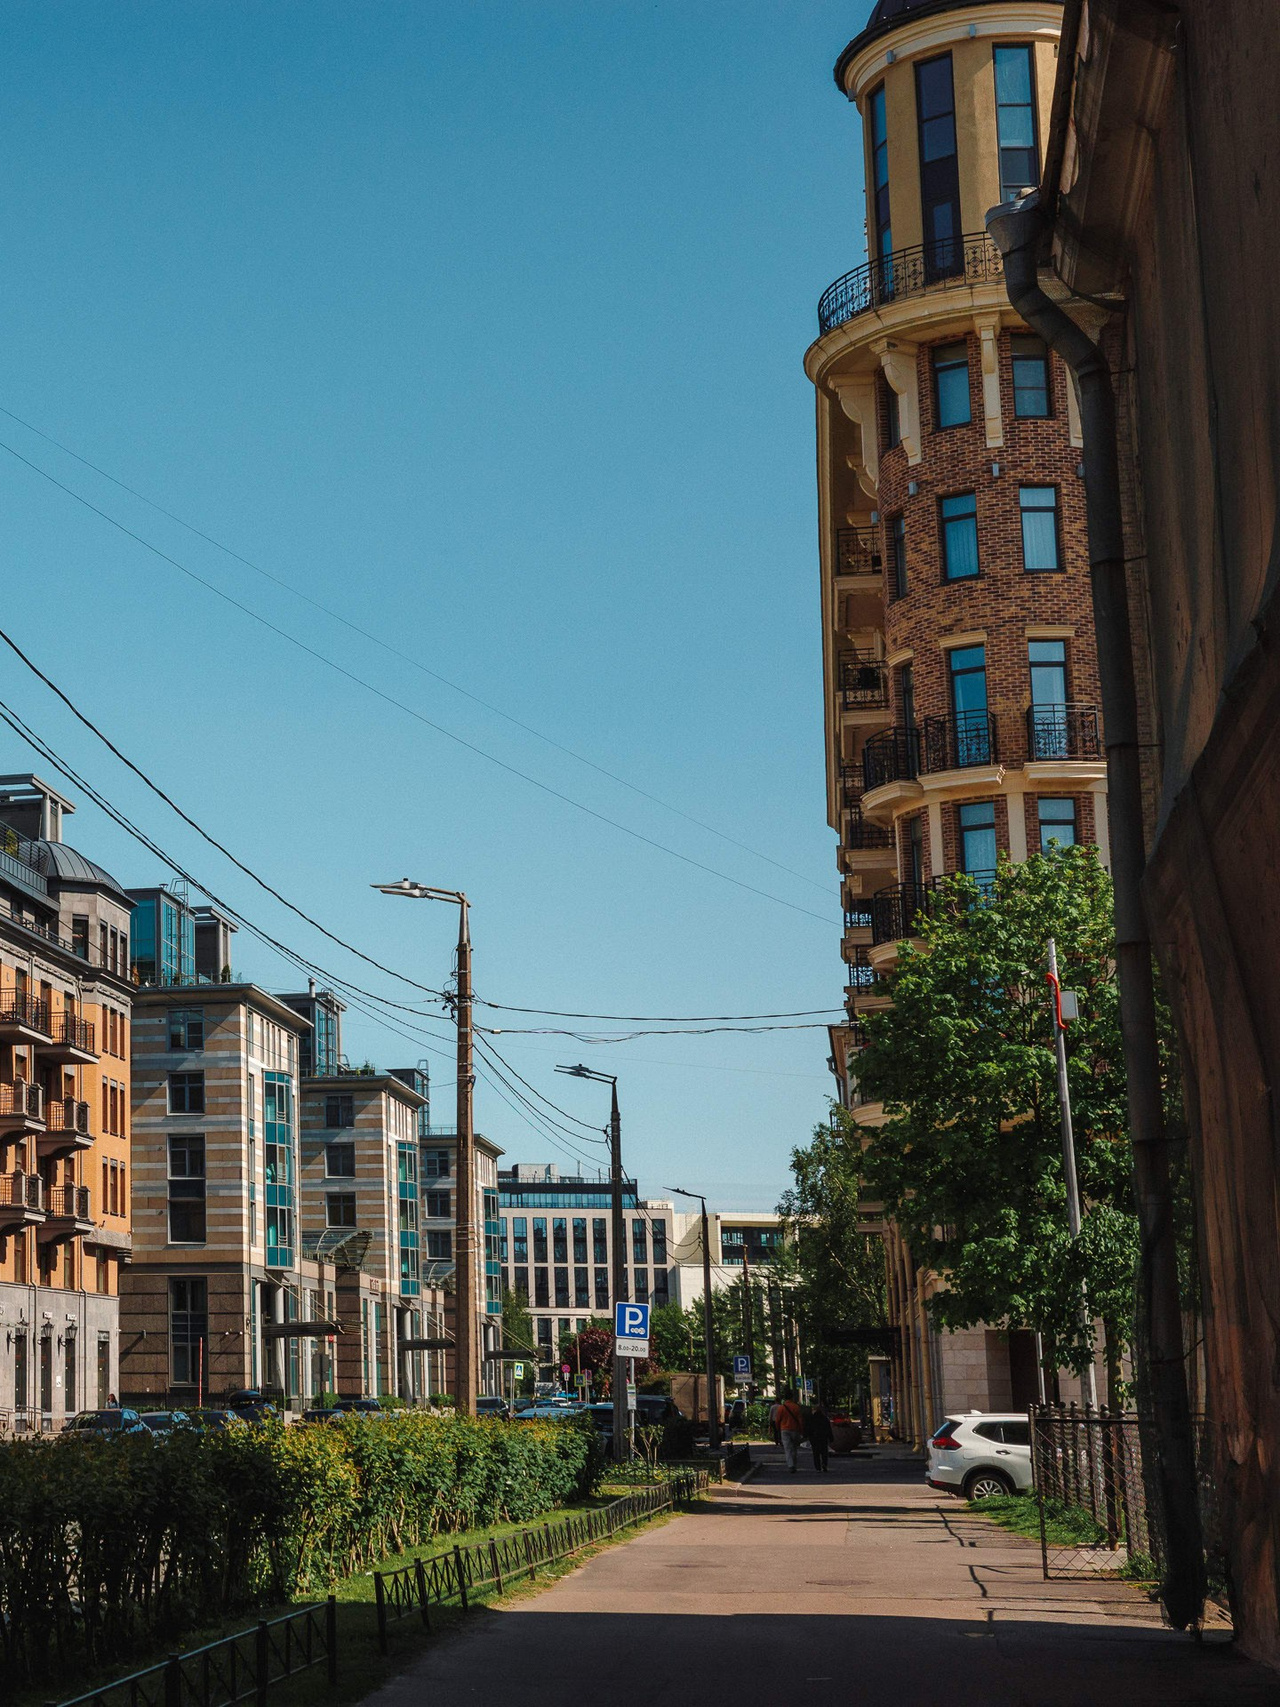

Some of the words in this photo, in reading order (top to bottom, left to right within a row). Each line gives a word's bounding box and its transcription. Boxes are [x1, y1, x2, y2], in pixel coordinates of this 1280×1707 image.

[625, 1307, 643, 1334] P
[618, 1344, 646, 1353] 8.00-20.00
[738, 1358, 747, 1371] P
